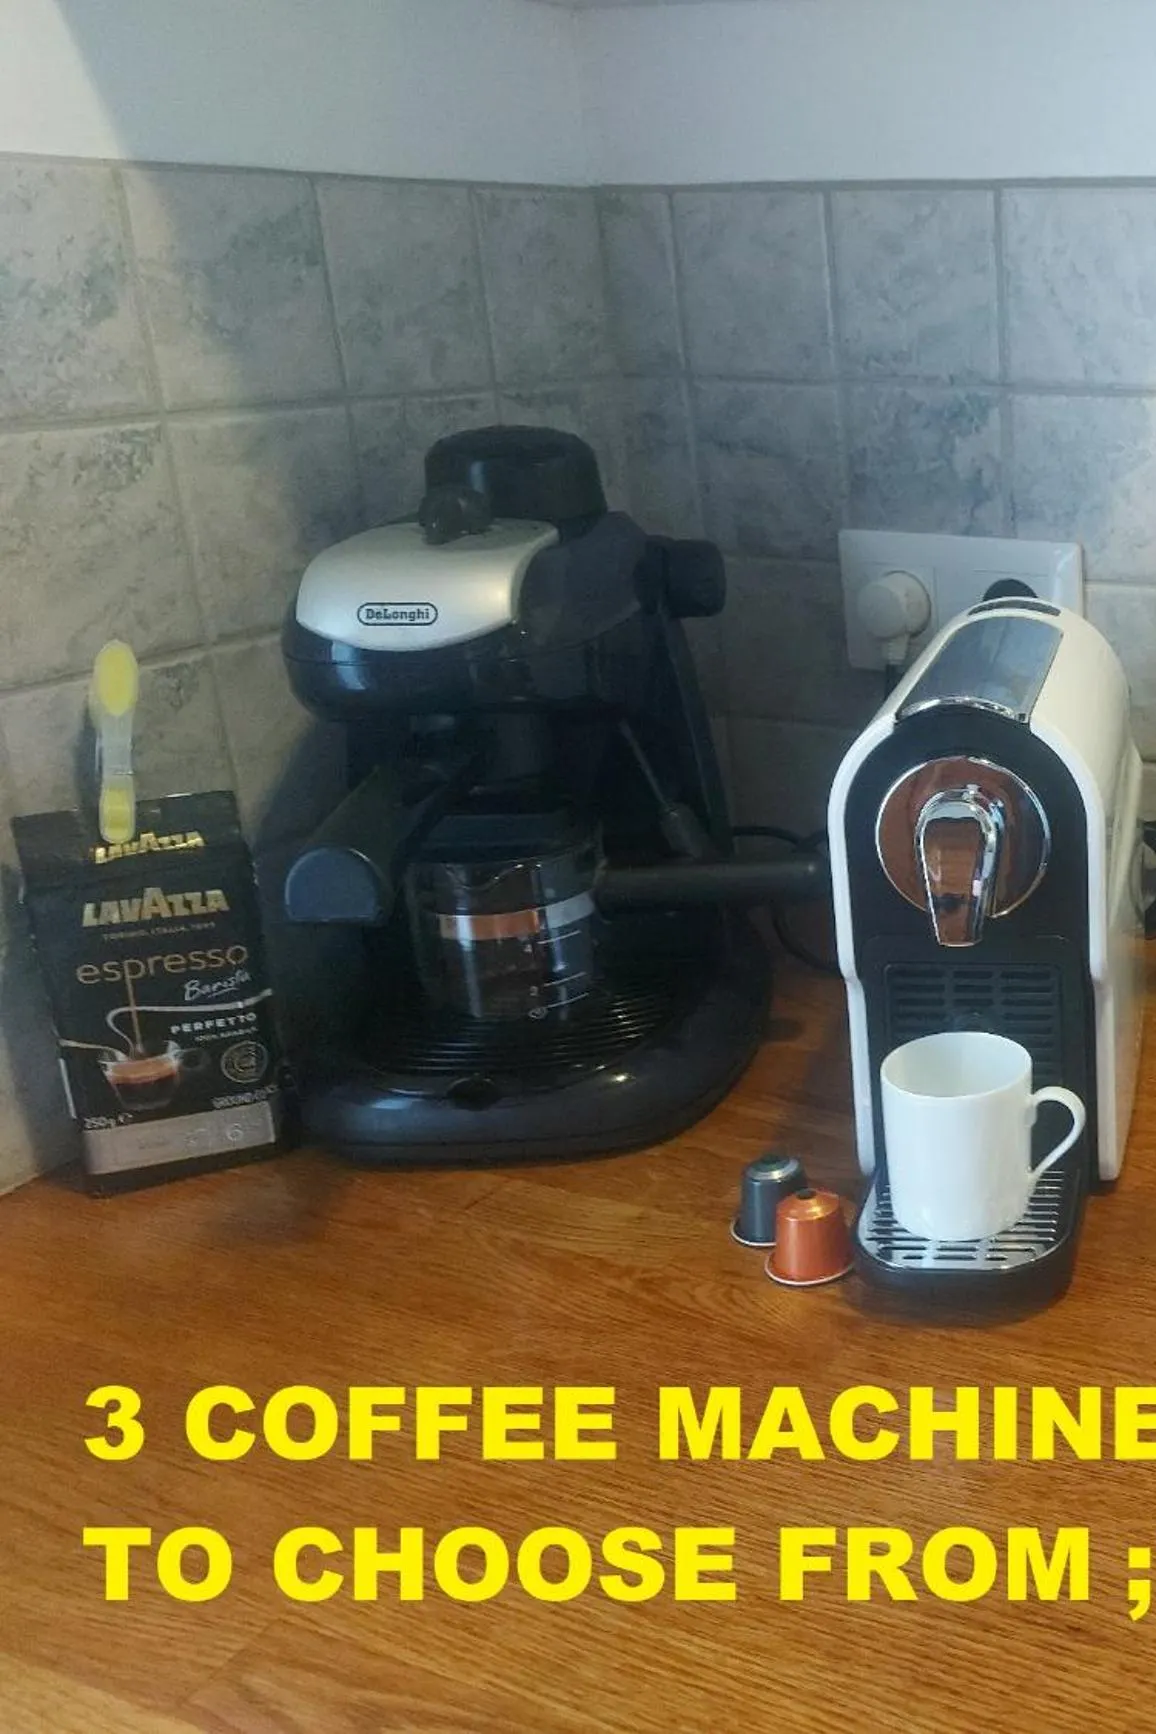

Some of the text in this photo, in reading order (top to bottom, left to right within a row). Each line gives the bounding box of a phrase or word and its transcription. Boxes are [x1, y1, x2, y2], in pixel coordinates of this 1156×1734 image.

[364, 607, 431, 622] DeLonghi
[82, 887, 230, 928] LAVAZZA
[75, 944, 250, 985] espresso
[170, 1012, 258, 1035] PERFETTO
